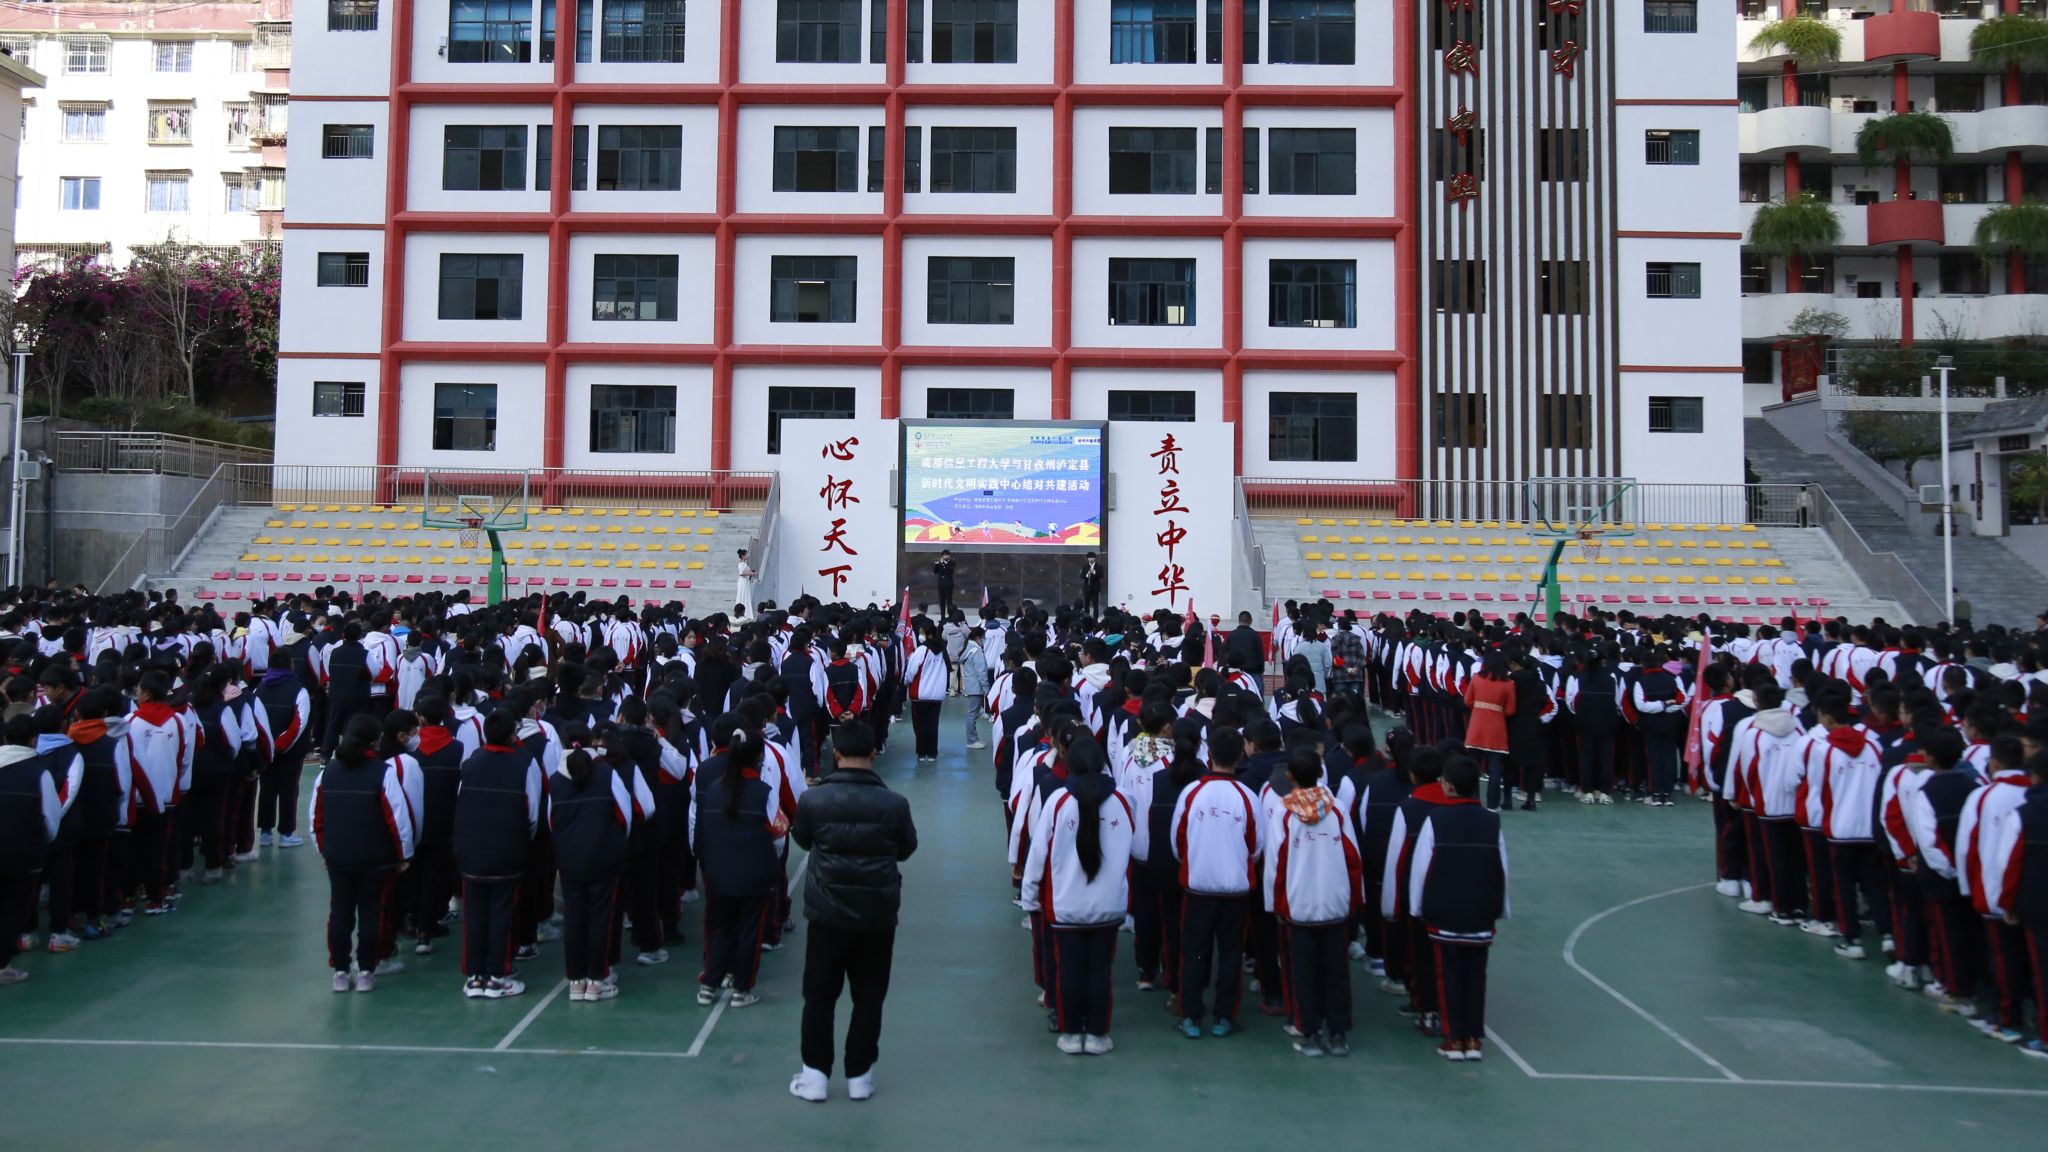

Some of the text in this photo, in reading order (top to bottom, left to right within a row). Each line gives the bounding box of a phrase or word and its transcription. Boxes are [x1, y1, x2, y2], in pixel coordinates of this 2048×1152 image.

[921, 457, 1090, 471] 成都信息工程大学与甘孜州泸定县
[921, 477, 1090, 492] 新时代文明实践中心结对共建活动
[818, 436, 860, 597] 心怀天下
[1150, 433, 1190, 608] 责立中华
